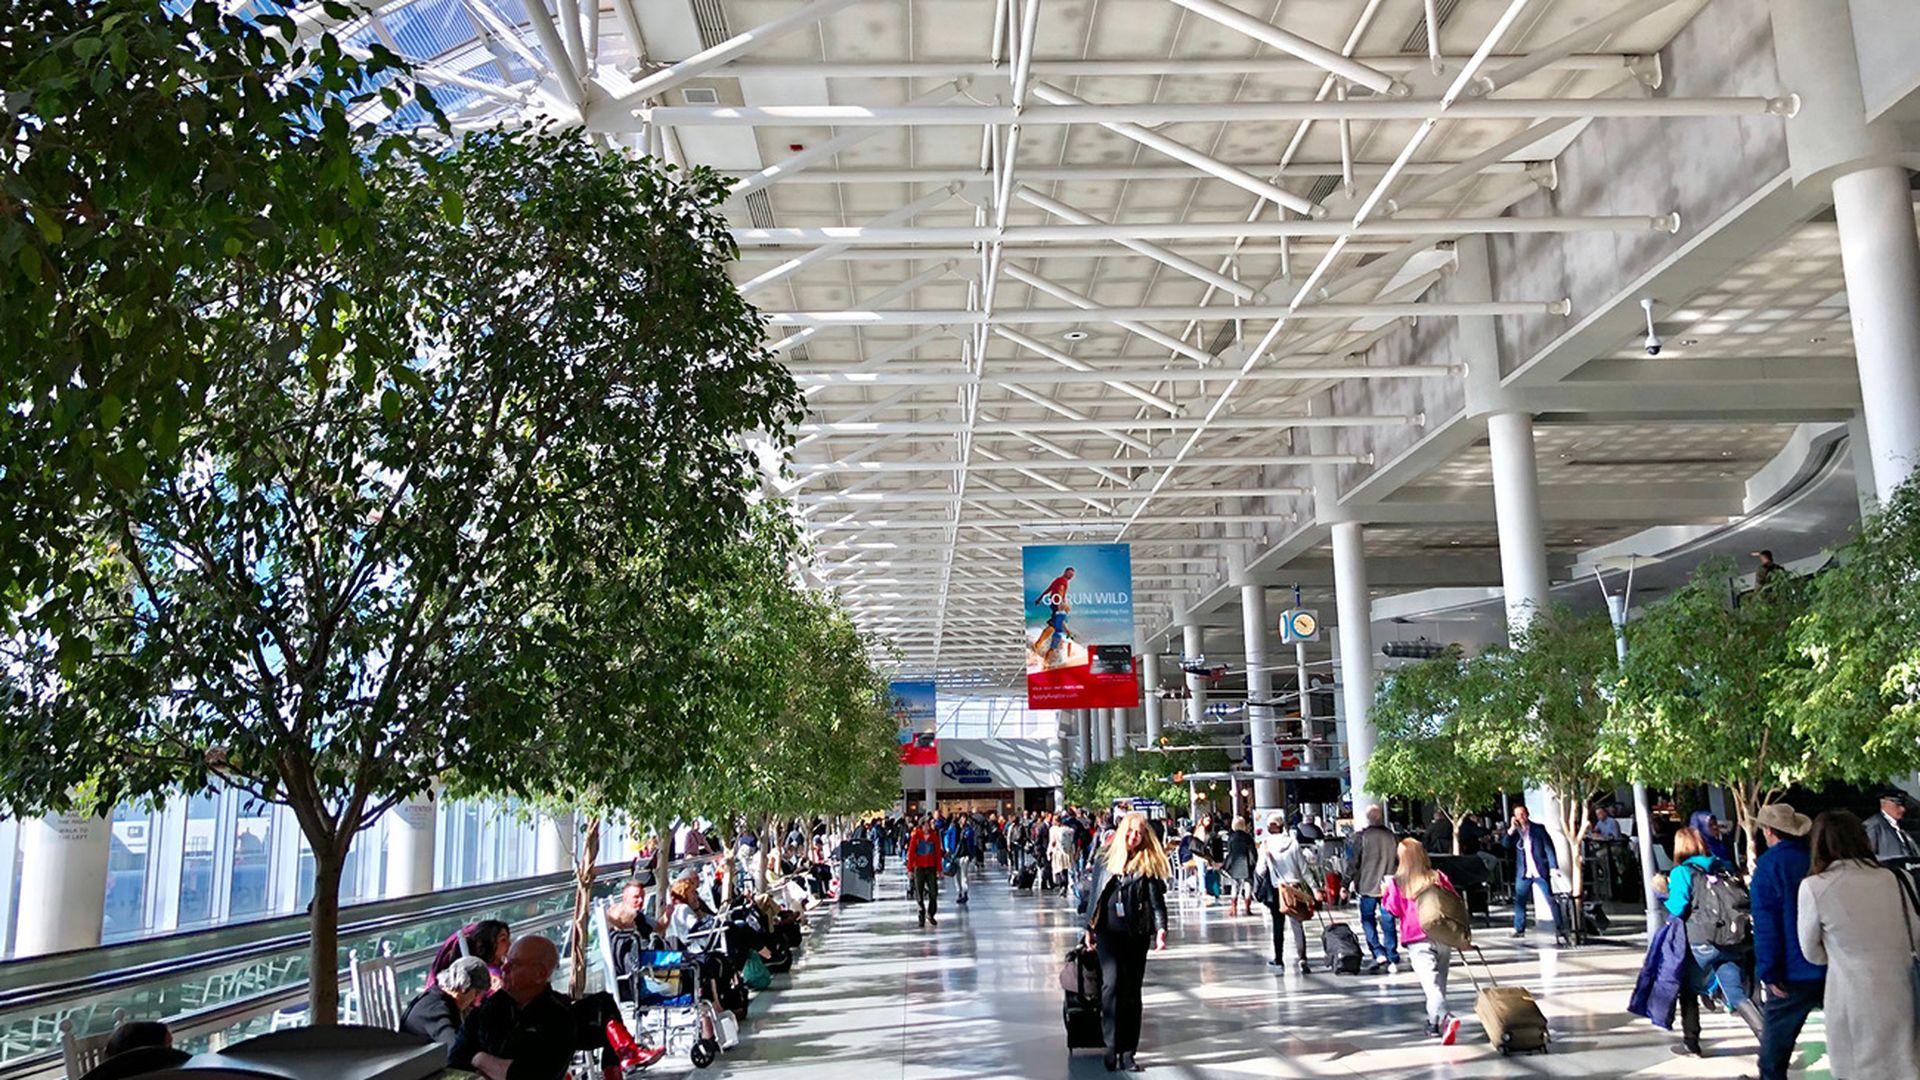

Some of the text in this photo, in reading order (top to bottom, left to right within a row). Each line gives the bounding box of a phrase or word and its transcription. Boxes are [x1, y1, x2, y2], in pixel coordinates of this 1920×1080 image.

[1042, 591, 1128, 606] GO RUN WILD
